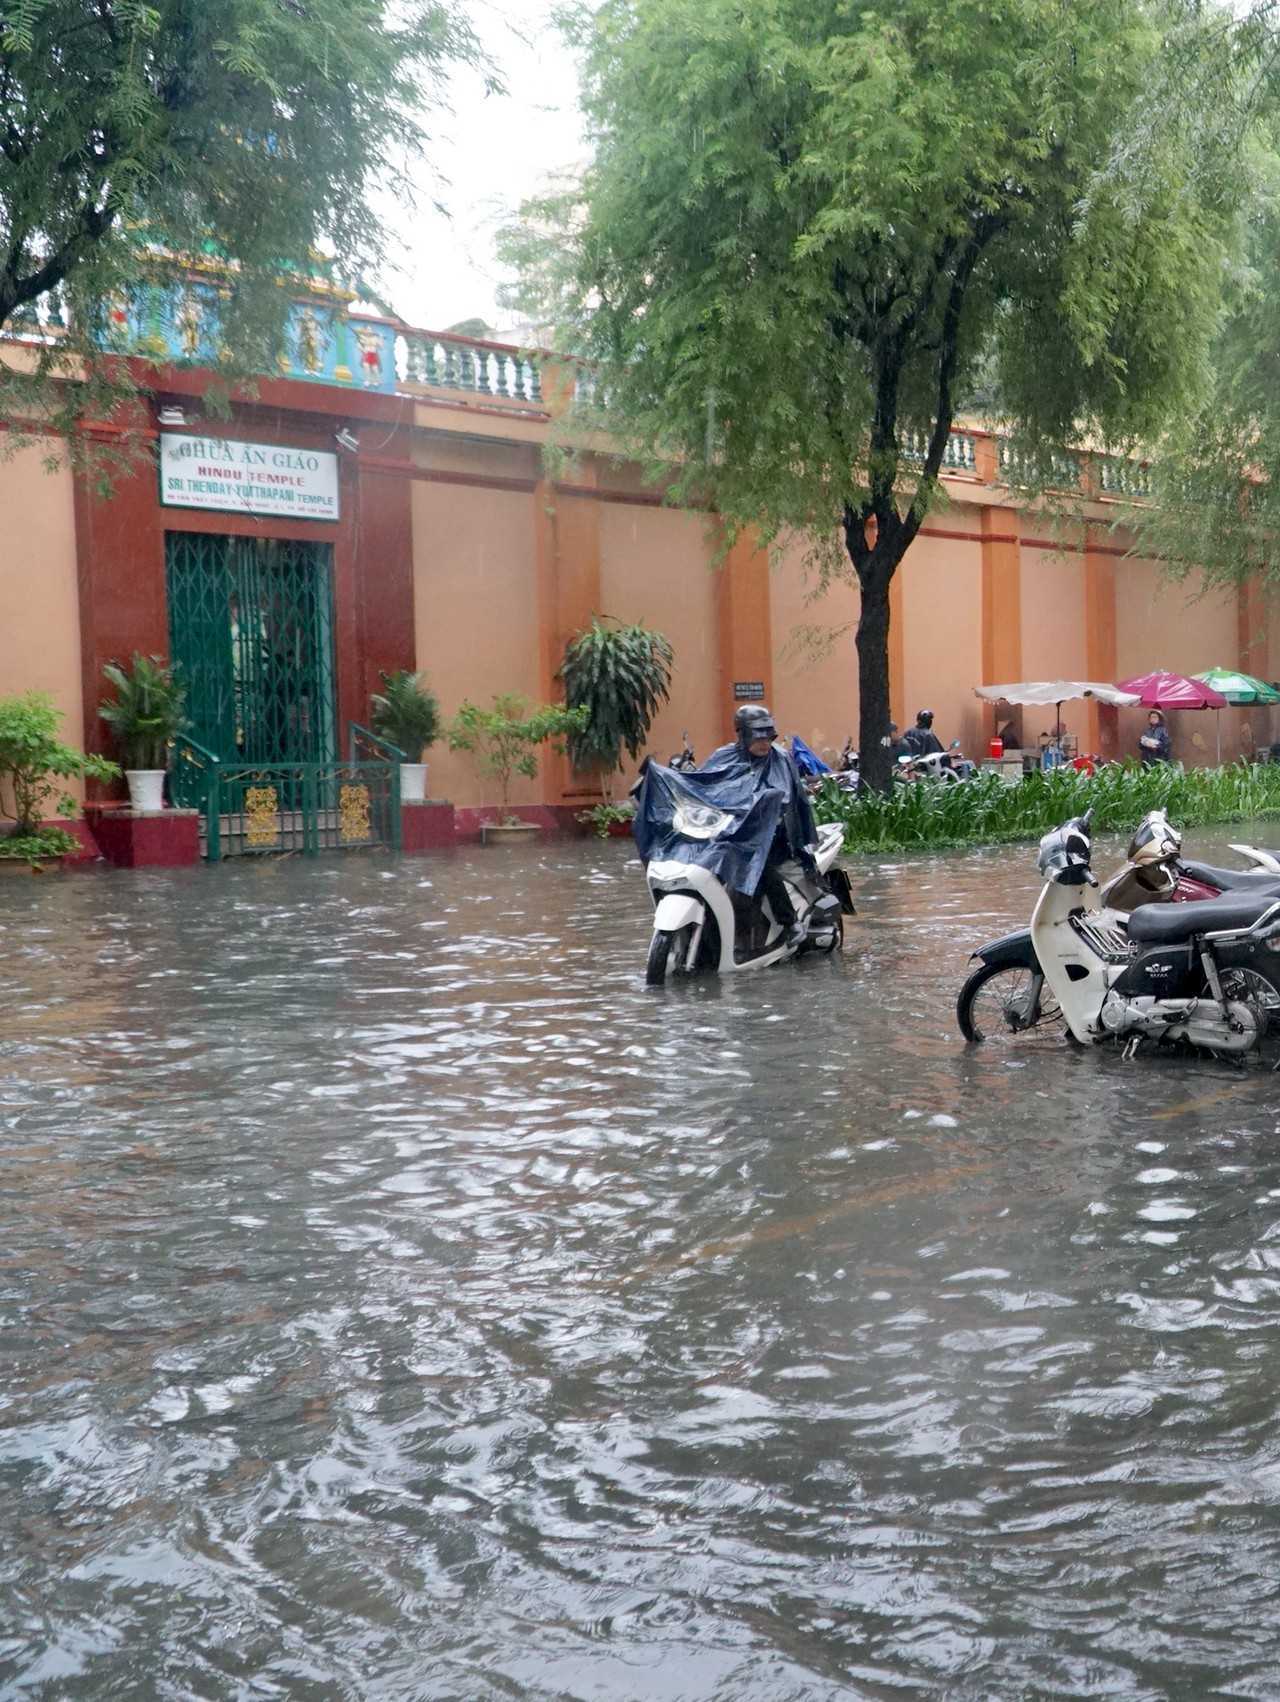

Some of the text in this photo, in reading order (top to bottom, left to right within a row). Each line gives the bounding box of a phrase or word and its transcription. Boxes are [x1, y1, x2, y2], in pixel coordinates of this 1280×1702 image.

[272, 452, 319, 471] GIÁO
[197, 466, 306, 487] HINDU TEMPLE
[187, 479, 232, 495] THENDAY
[296, 494, 334, 506] TEMPLE
